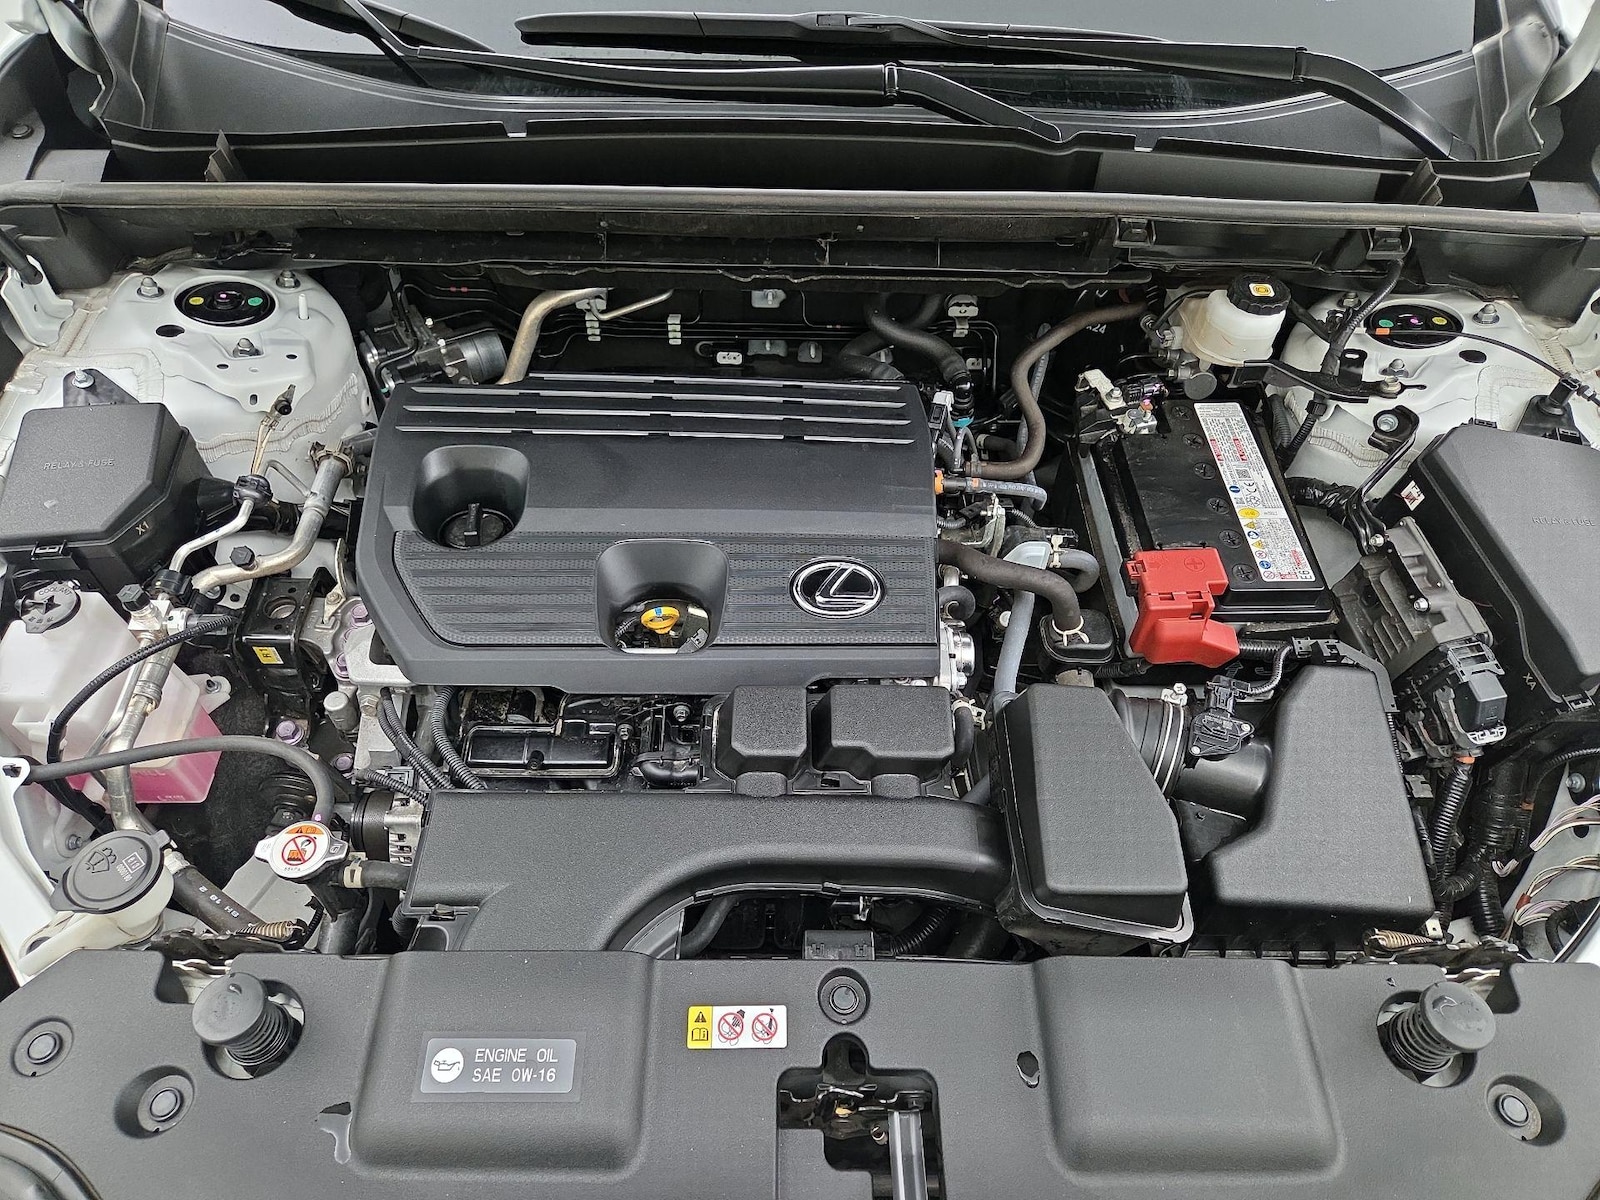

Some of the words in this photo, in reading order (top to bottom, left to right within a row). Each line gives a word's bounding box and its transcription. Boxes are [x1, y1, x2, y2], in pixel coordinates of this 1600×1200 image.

[43, 460, 76, 470] RELAY
[88, 458, 115, 467] FUSE
[38, 586, 72, 596] COOLANT
[474, 1048, 527, 1063] ENGINE
[536, 1048, 559, 1063] OIL
[472, 1068, 502, 1083] SAE
[511, 1068, 556, 1083] 0W-16
